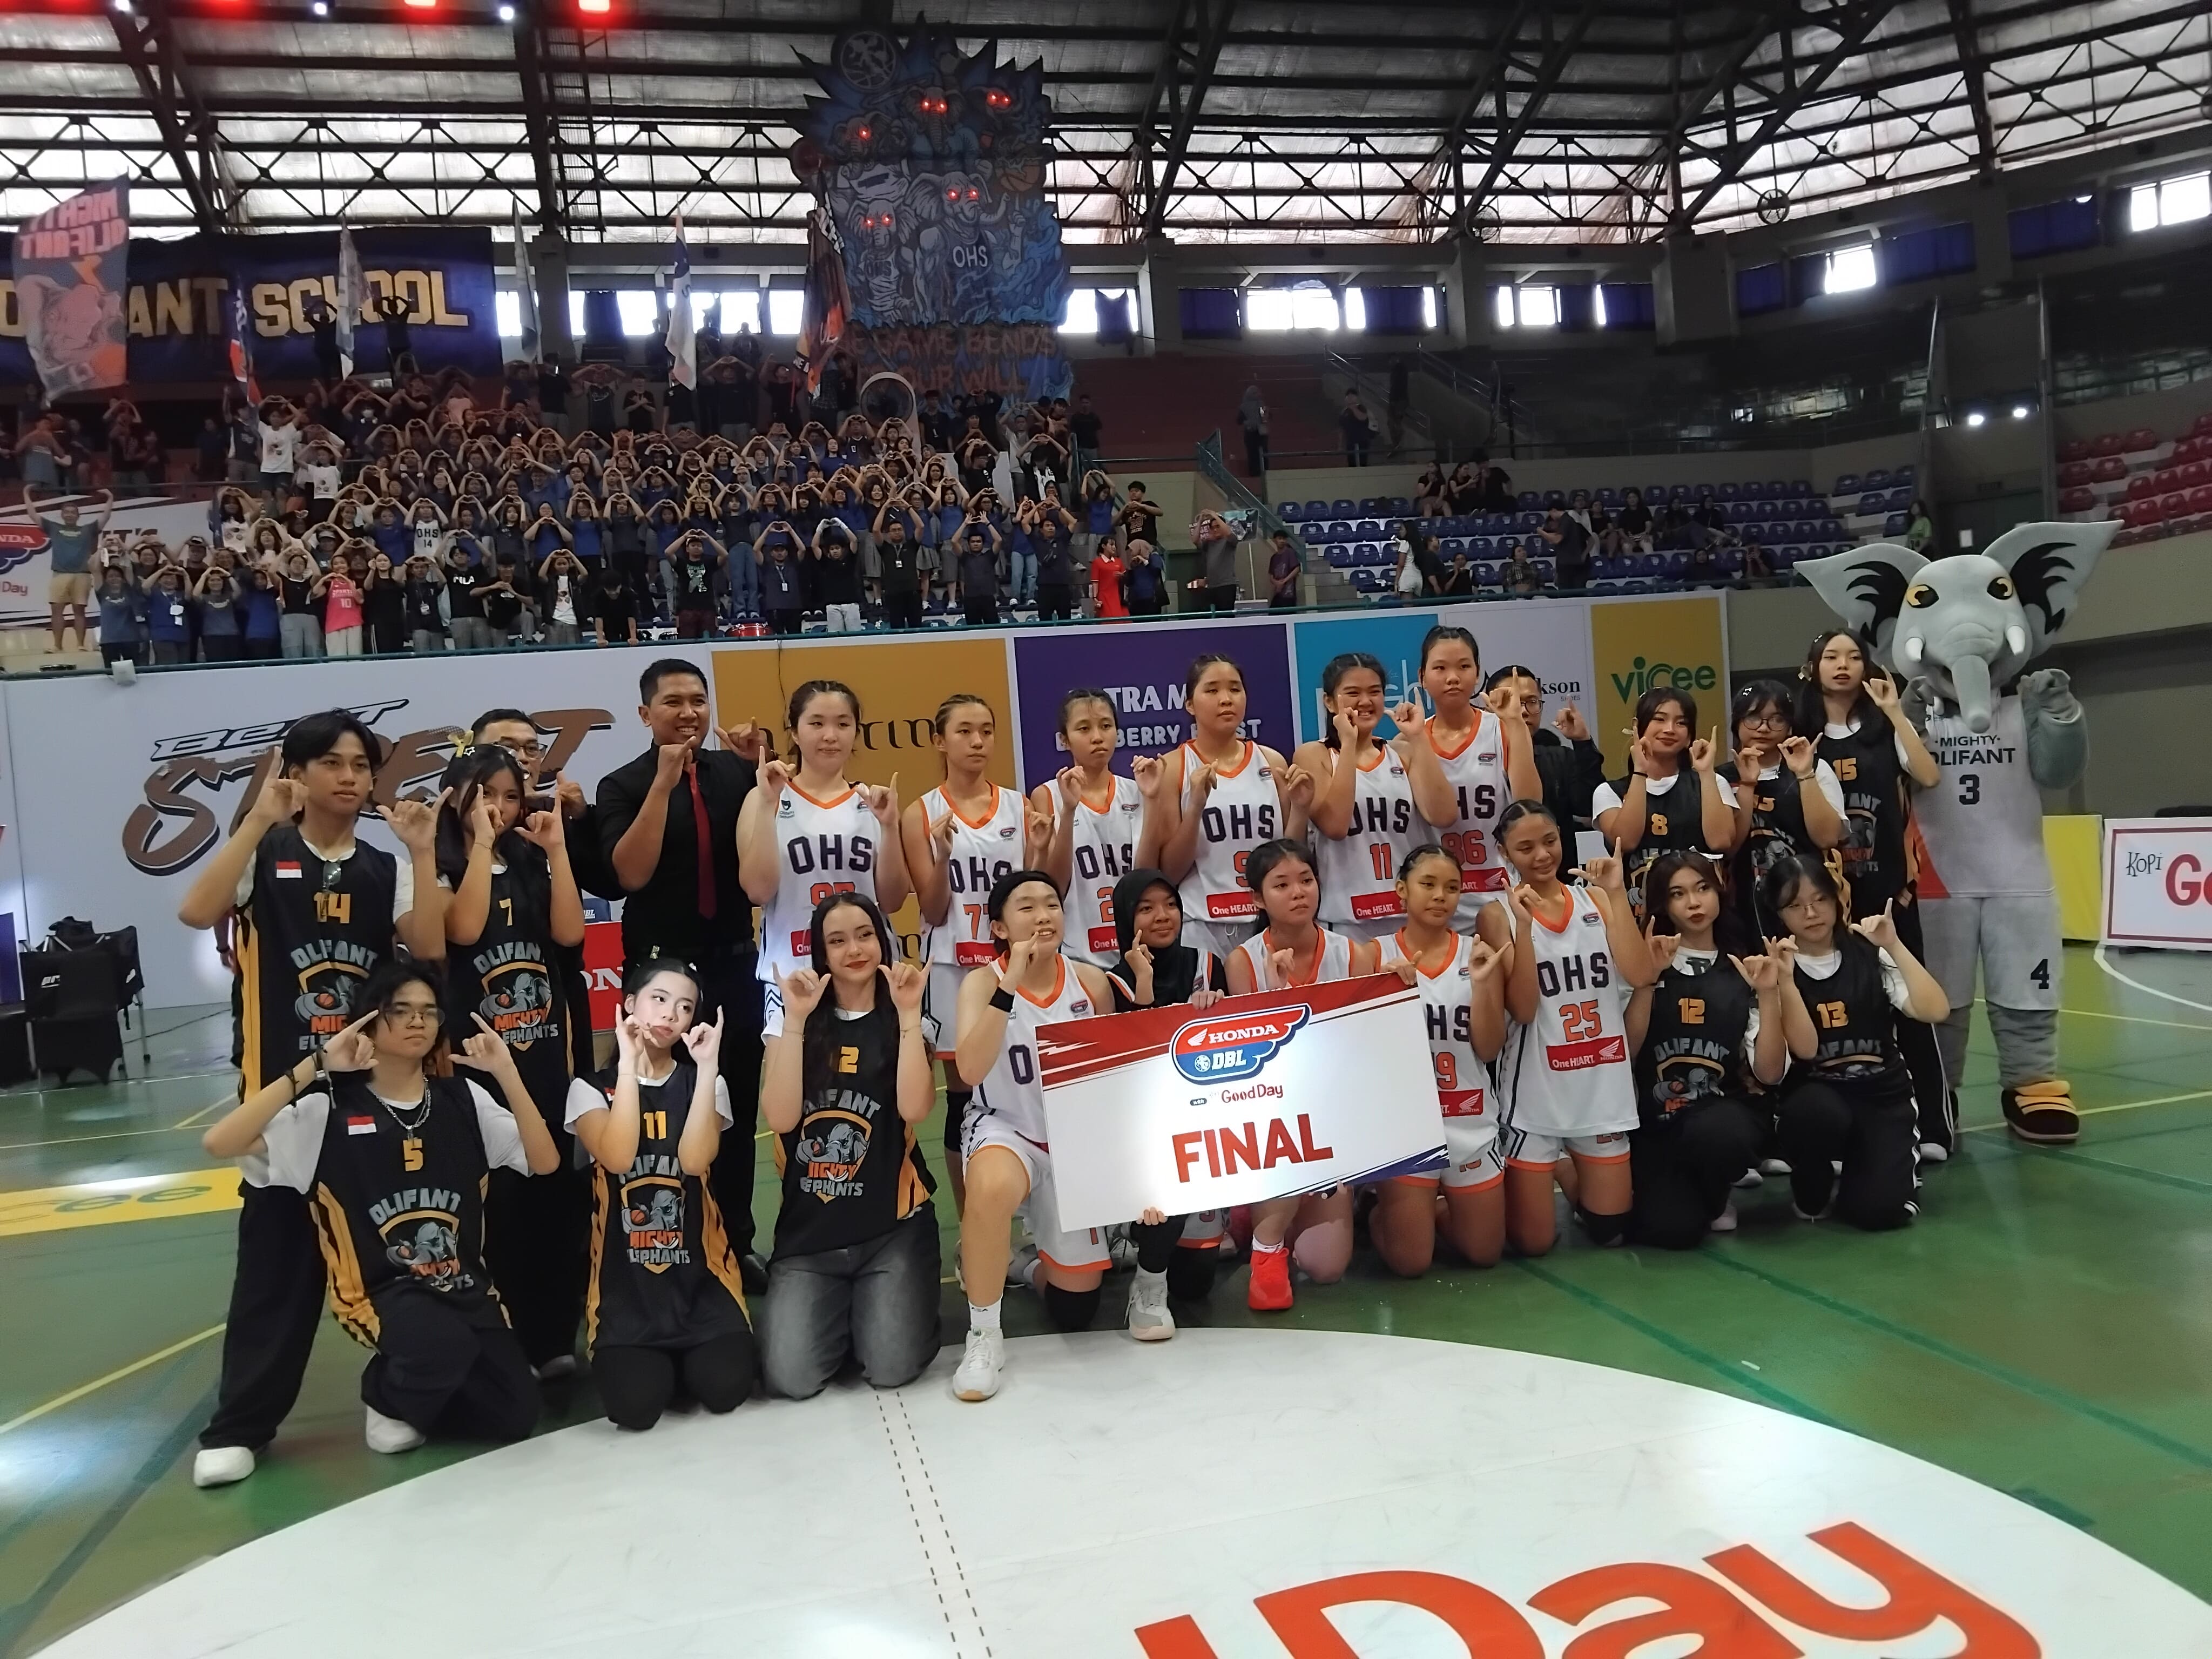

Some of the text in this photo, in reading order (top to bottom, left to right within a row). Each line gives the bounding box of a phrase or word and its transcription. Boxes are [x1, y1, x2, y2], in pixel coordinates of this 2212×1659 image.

[952, 245, 988, 268] OHS
[0, 535, 35, 544] NDA
[417, 528, 439, 538] OHS
[423, 539, 432, 548] 14
[2, 581, 29, 595] Day
[341, 598, 352, 608] 10
[1536, 678, 1581, 694] kson
[1610, 656, 1716, 705] vicee
[1103, 685, 1163, 713] TRA
[1940, 734, 1998, 747] MIGHTY
[1832, 757, 1857, 781] 15
[1959, 774, 1980, 805] 3
[1202, 804, 1274, 843] OHS
[1651, 813, 1668, 835] 8
[787, 834, 873, 874] OHS
[1369, 842, 1393, 880] 11
[313, 892, 350, 924] 14
[498, 898, 512, 927] 7
[1212, 906, 1229, 915] One
[1356, 908, 1372, 917] One
[291, 939, 377, 970] OLIFANT
[473, 941, 545, 974] OLIFAN
[1094, 940, 1110, 949] One
[959, 955, 973, 964] One
[1536, 952, 1609, 998] OHS
[2030, 959, 2049, 990] 4
[493, 1007, 548, 1031] MIGHTY
[1426, 1003, 1471, 1042] HS
[1559, 999, 1603, 1042] 25
[1678, 997, 1705, 1024] 12
[1816, 1001, 1849, 1028] 13
[502, 1023, 559, 1044] EPHANTS
[1208, 1024, 1279, 1044] HONDA
[839, 1046, 860, 1074] 2
[1211, 1049, 1246, 1070] DBL
[1654, 1037, 1730, 1062] OLIFANT
[1432, 1051, 1458, 1090] 9
[1552, 1058, 1570, 1069] One
[643, 1110, 666, 1140] 11
[403, 1137, 423, 1171] 5
[1172, 1113, 1334, 1183] FINAL
[368, 1188, 461, 1225] OLIFANT
